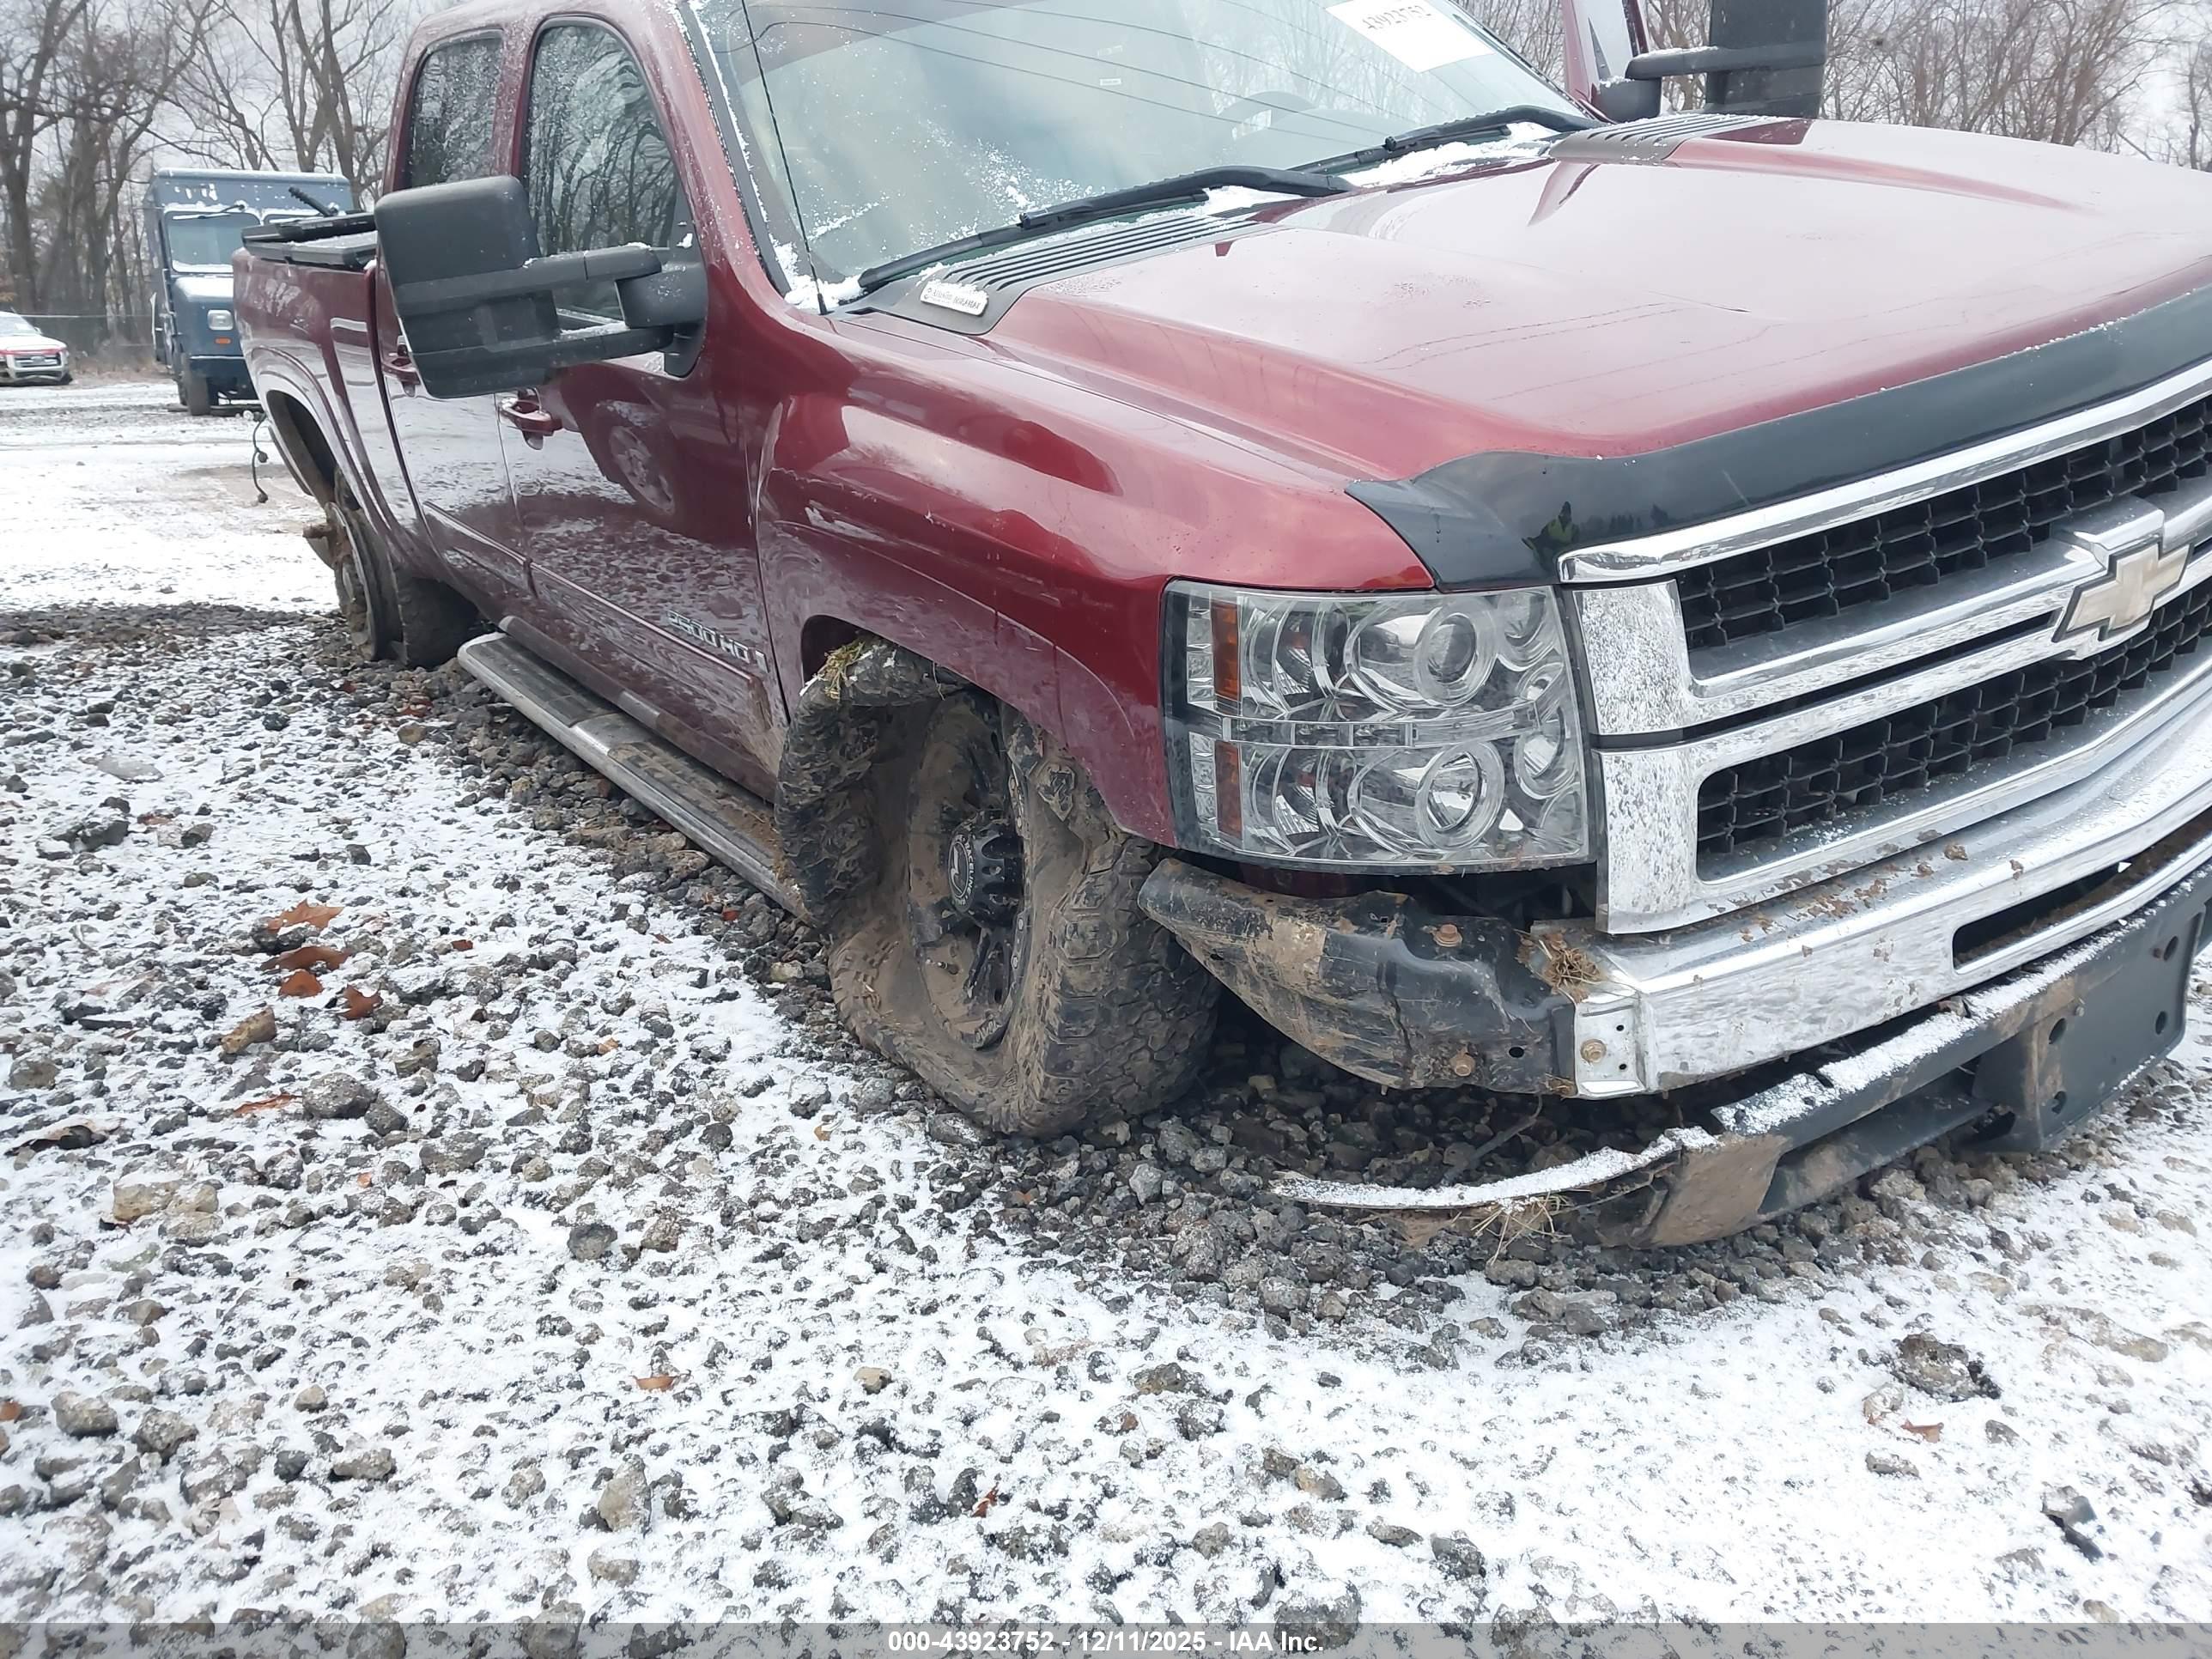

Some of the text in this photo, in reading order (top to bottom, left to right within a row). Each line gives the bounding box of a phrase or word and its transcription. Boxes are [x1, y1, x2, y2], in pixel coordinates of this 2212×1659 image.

[667, 610, 750, 664] 2500 HD
[963, 841, 975, 896] RACELINE
